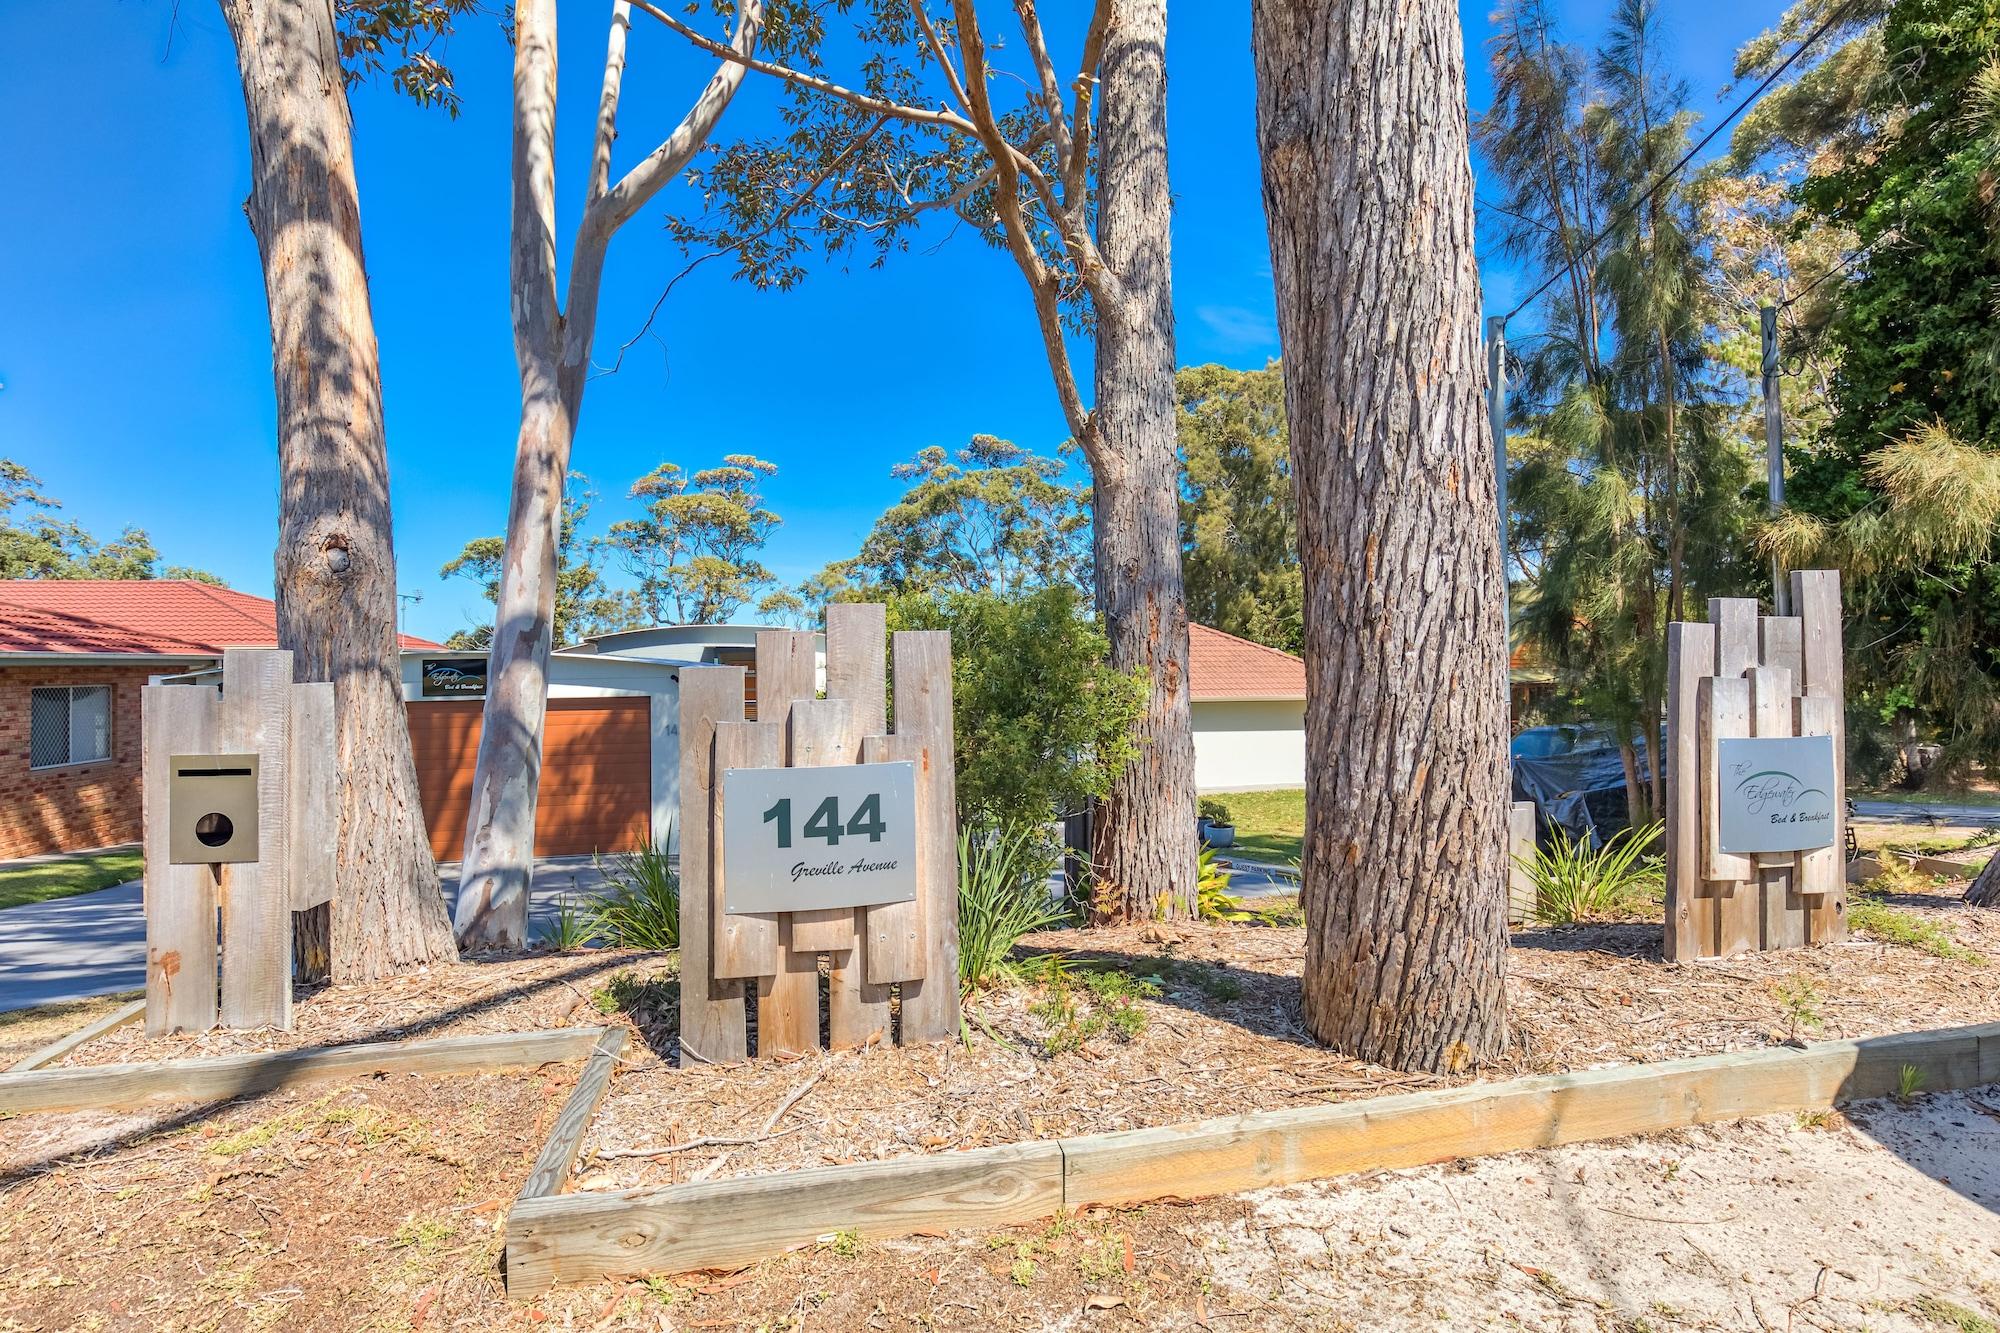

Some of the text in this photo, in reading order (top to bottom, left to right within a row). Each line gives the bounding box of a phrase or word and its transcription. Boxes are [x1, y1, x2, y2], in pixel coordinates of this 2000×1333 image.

[665, 724, 679, 736] 14
[1729, 760, 1752, 776] The
[1743, 777, 1795, 815] Edgewater
[763, 793, 887, 849] 144
[1770, 811, 1830, 824] Bed & Breakfast
[790, 857, 898, 882] Greville Avenue
